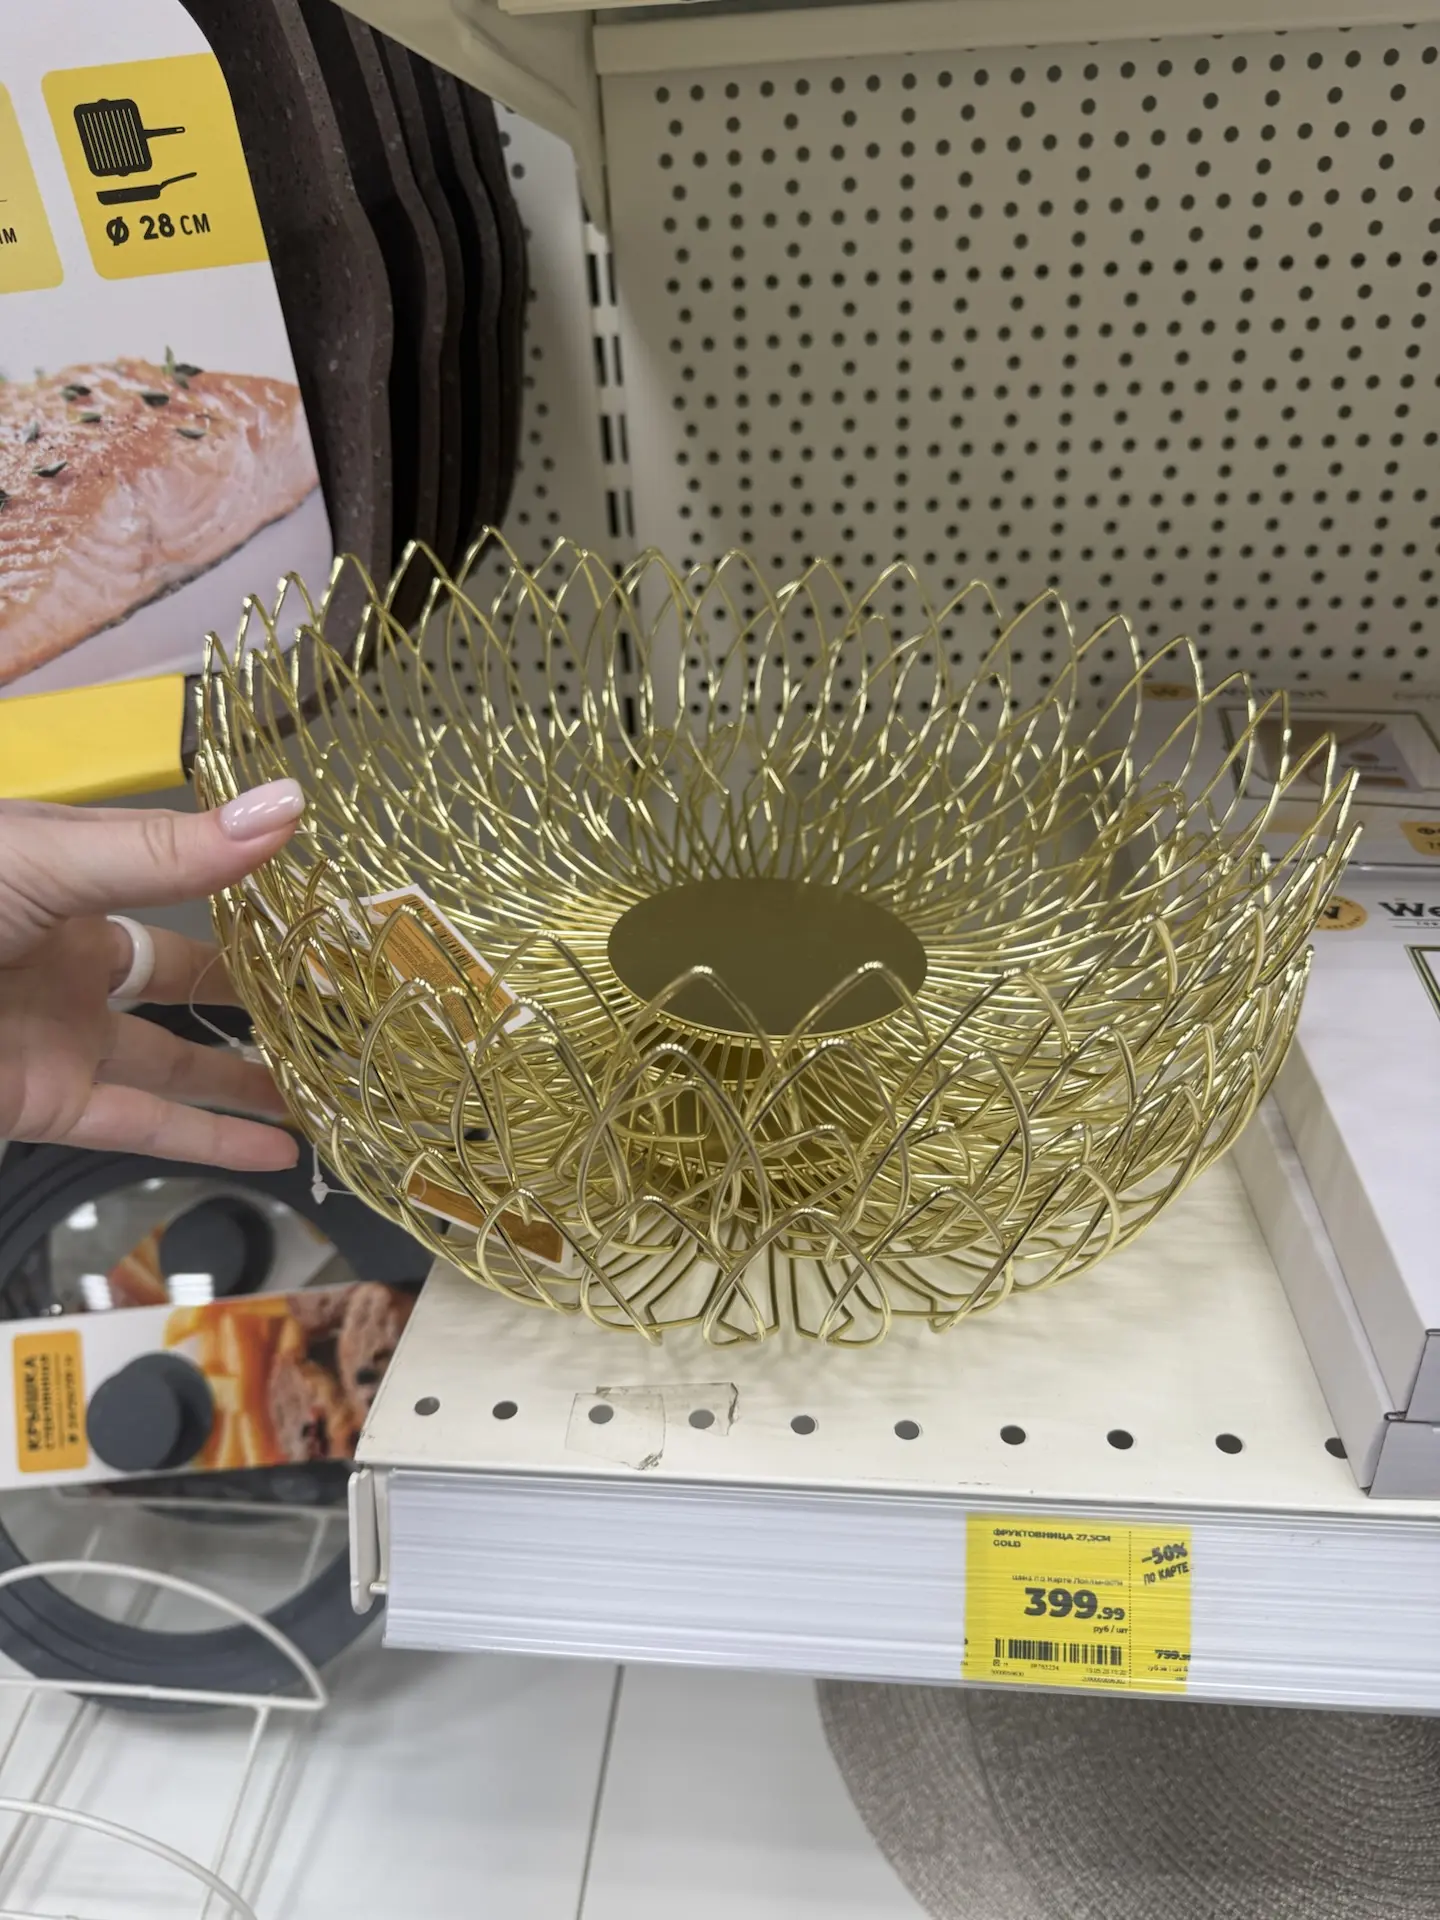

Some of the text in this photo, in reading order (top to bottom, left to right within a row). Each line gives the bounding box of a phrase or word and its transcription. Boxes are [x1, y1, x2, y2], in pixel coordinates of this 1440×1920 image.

[139, 213, 176, 241] 28
[993, 1528, 1074, 1541] ФРУКТОВНИЦА
[993, 1539, 1021, 1548] GOLD
[1143, 1561, 1190, 1586] ПО КАРТЕ
